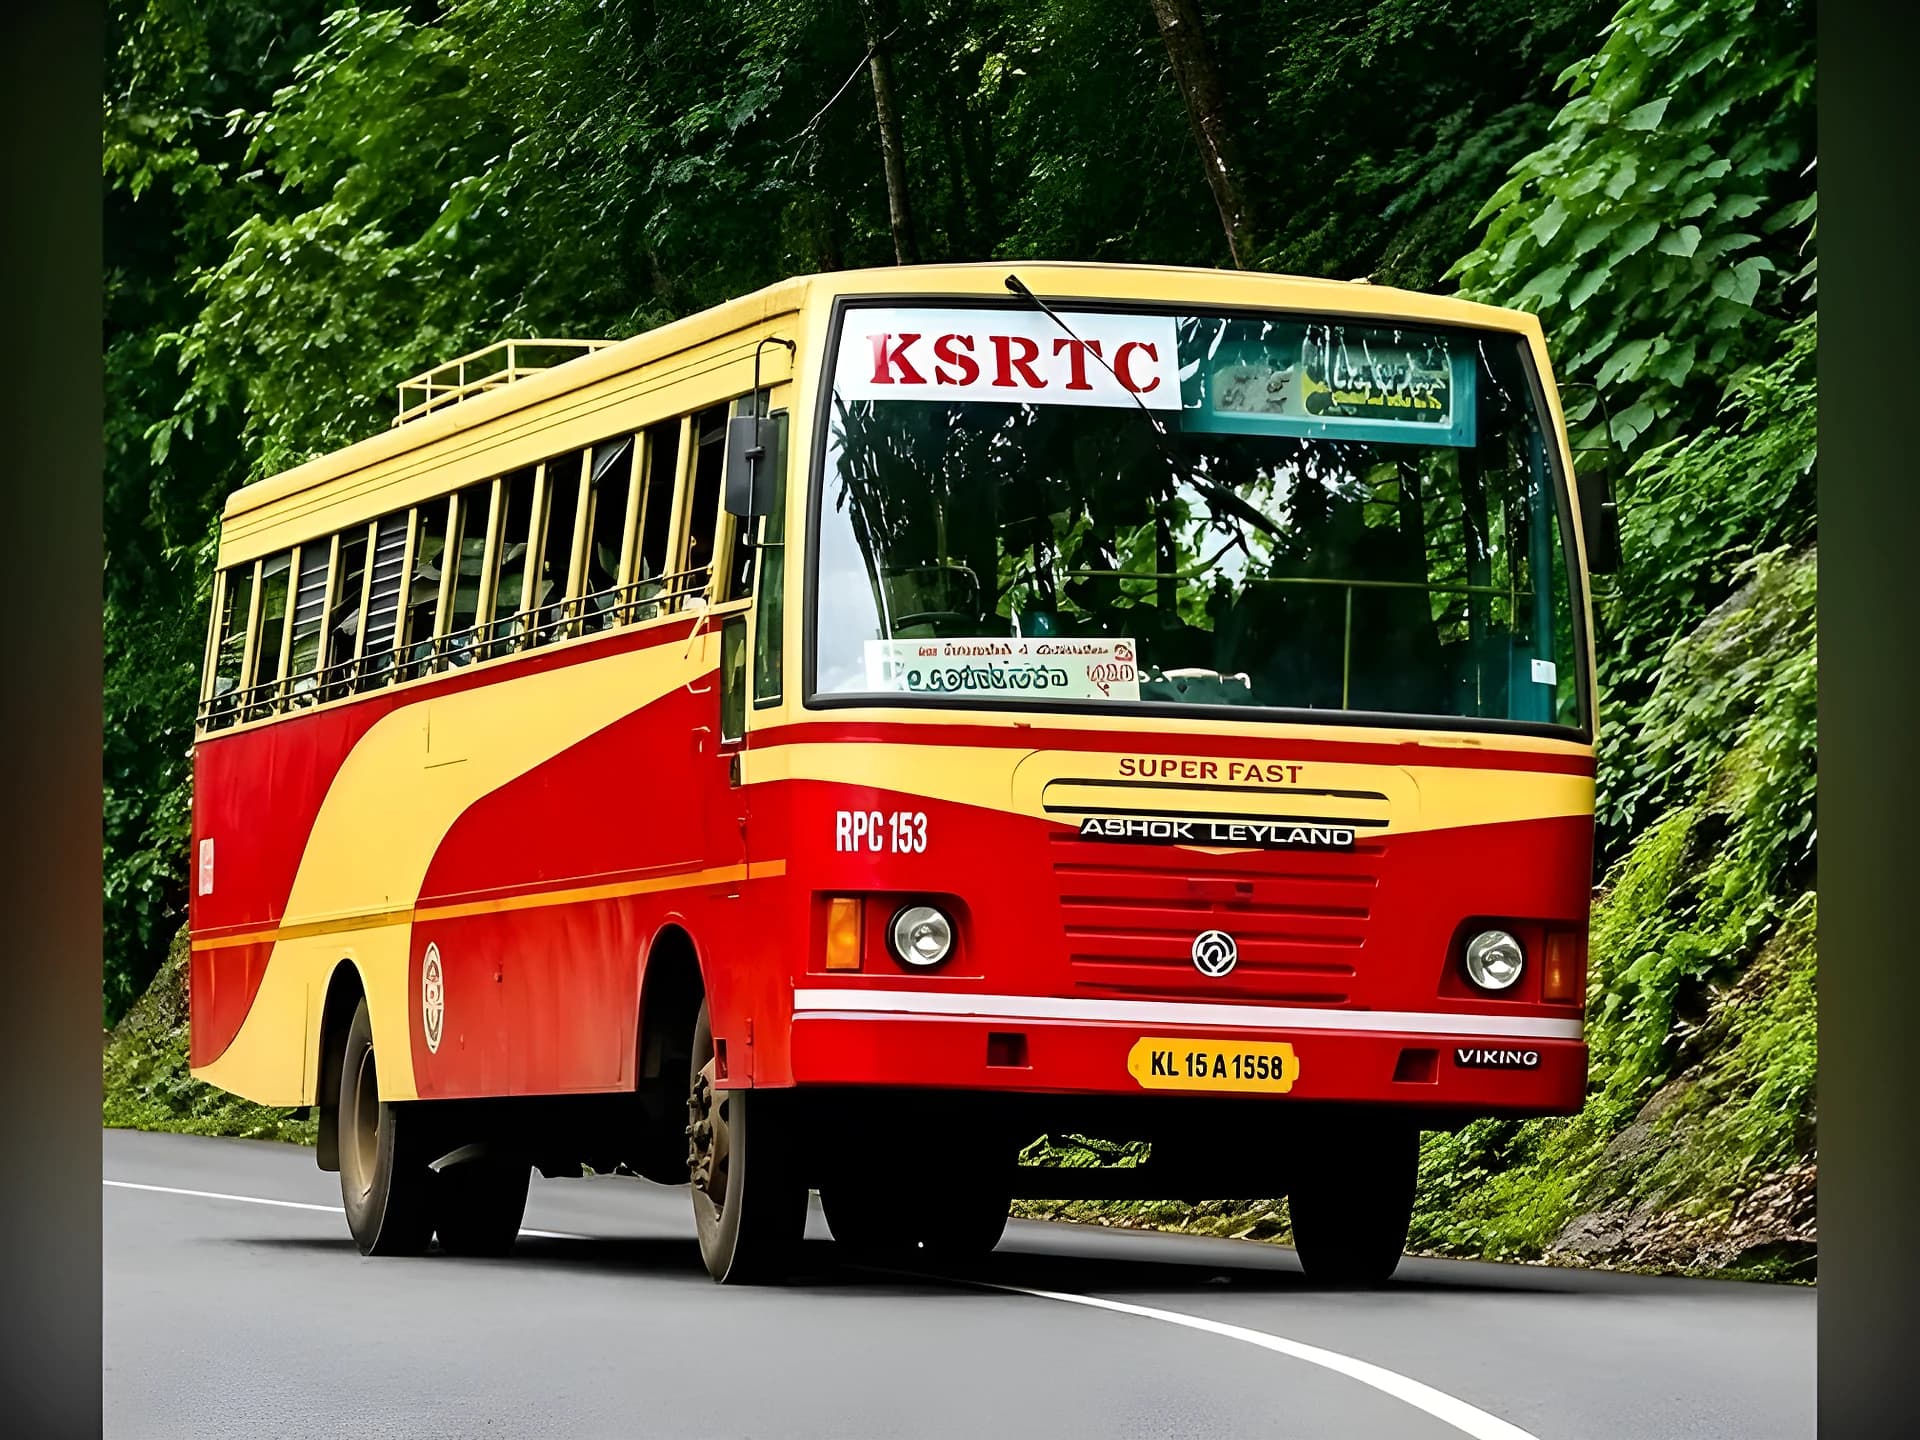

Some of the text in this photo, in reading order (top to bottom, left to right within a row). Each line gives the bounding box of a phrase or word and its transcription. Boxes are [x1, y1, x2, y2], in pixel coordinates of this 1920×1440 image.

[866, 333, 1161, 393] KSRTC
[1118, 758, 1303, 783] SUPER FAST
[836, 810, 928, 853] RPC 153
[1080, 818, 1353, 846] ASHOK LEYLAND
[1151, 1051, 1283, 1080] KL 15 A 1558
[1457, 1048, 1538, 1066] VIKING
